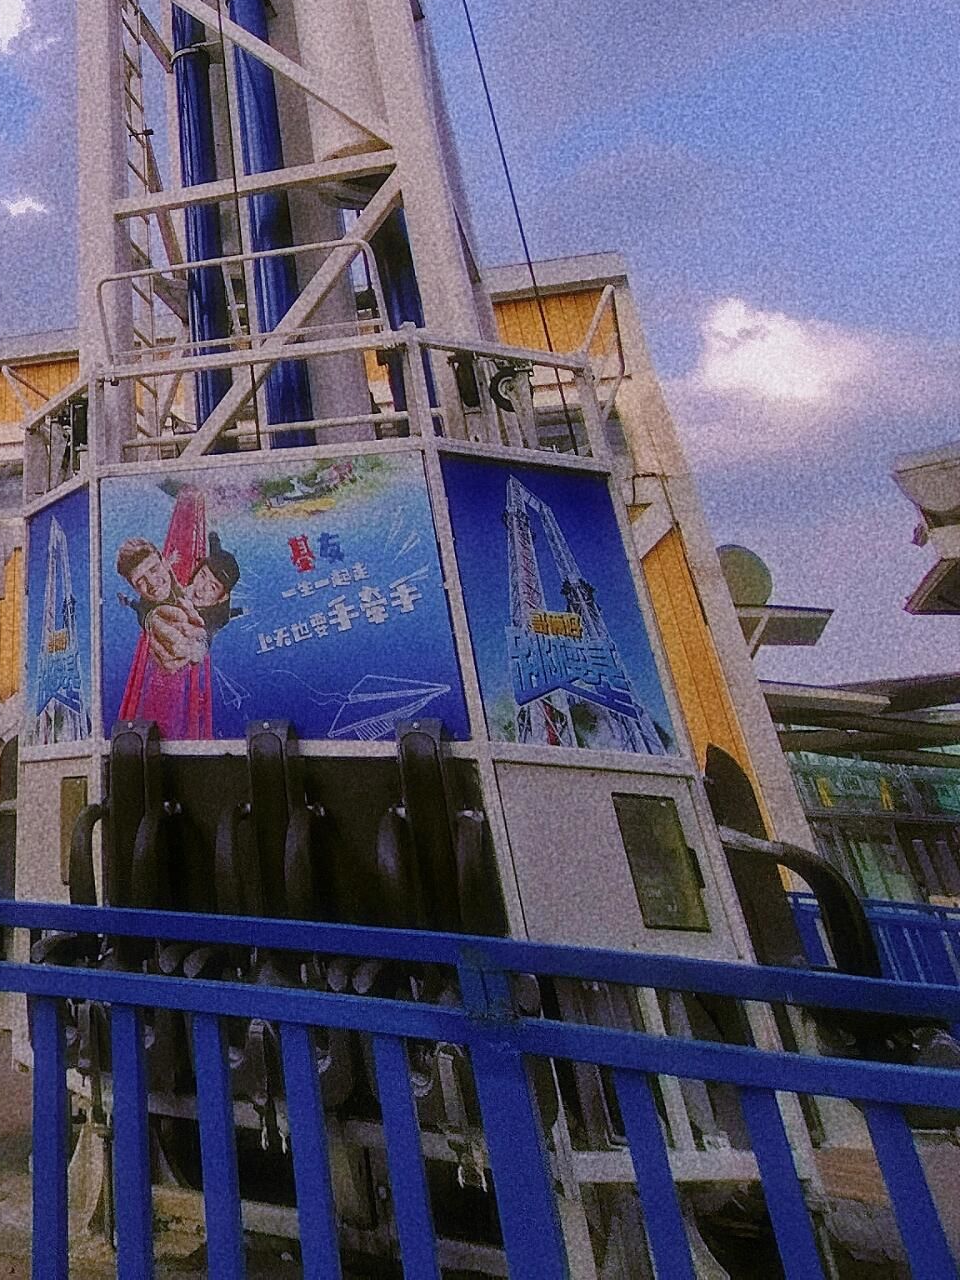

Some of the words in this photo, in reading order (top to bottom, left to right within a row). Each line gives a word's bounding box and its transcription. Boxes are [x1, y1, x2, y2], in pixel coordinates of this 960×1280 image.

[281, 561, 370, 599] 一生一起走
[256, 576, 422, 654] 上天也要手牵手
